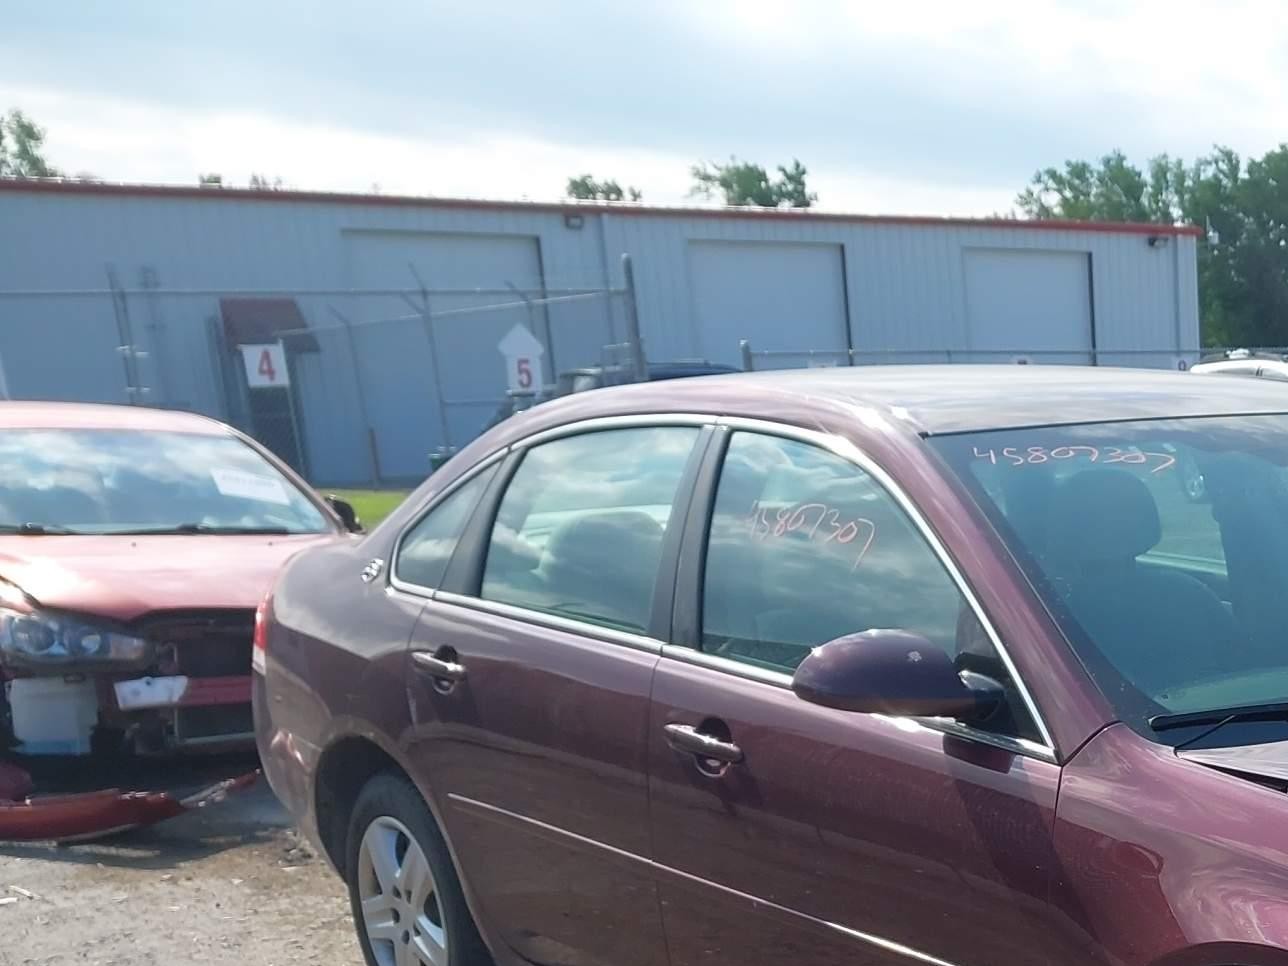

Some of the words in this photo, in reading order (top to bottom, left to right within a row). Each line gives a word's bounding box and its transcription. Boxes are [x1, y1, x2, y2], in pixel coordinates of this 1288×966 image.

[258, 350, 276, 382] 4
[516, 358, 532, 388] 5
[973, 446, 1176, 473] 45807307
